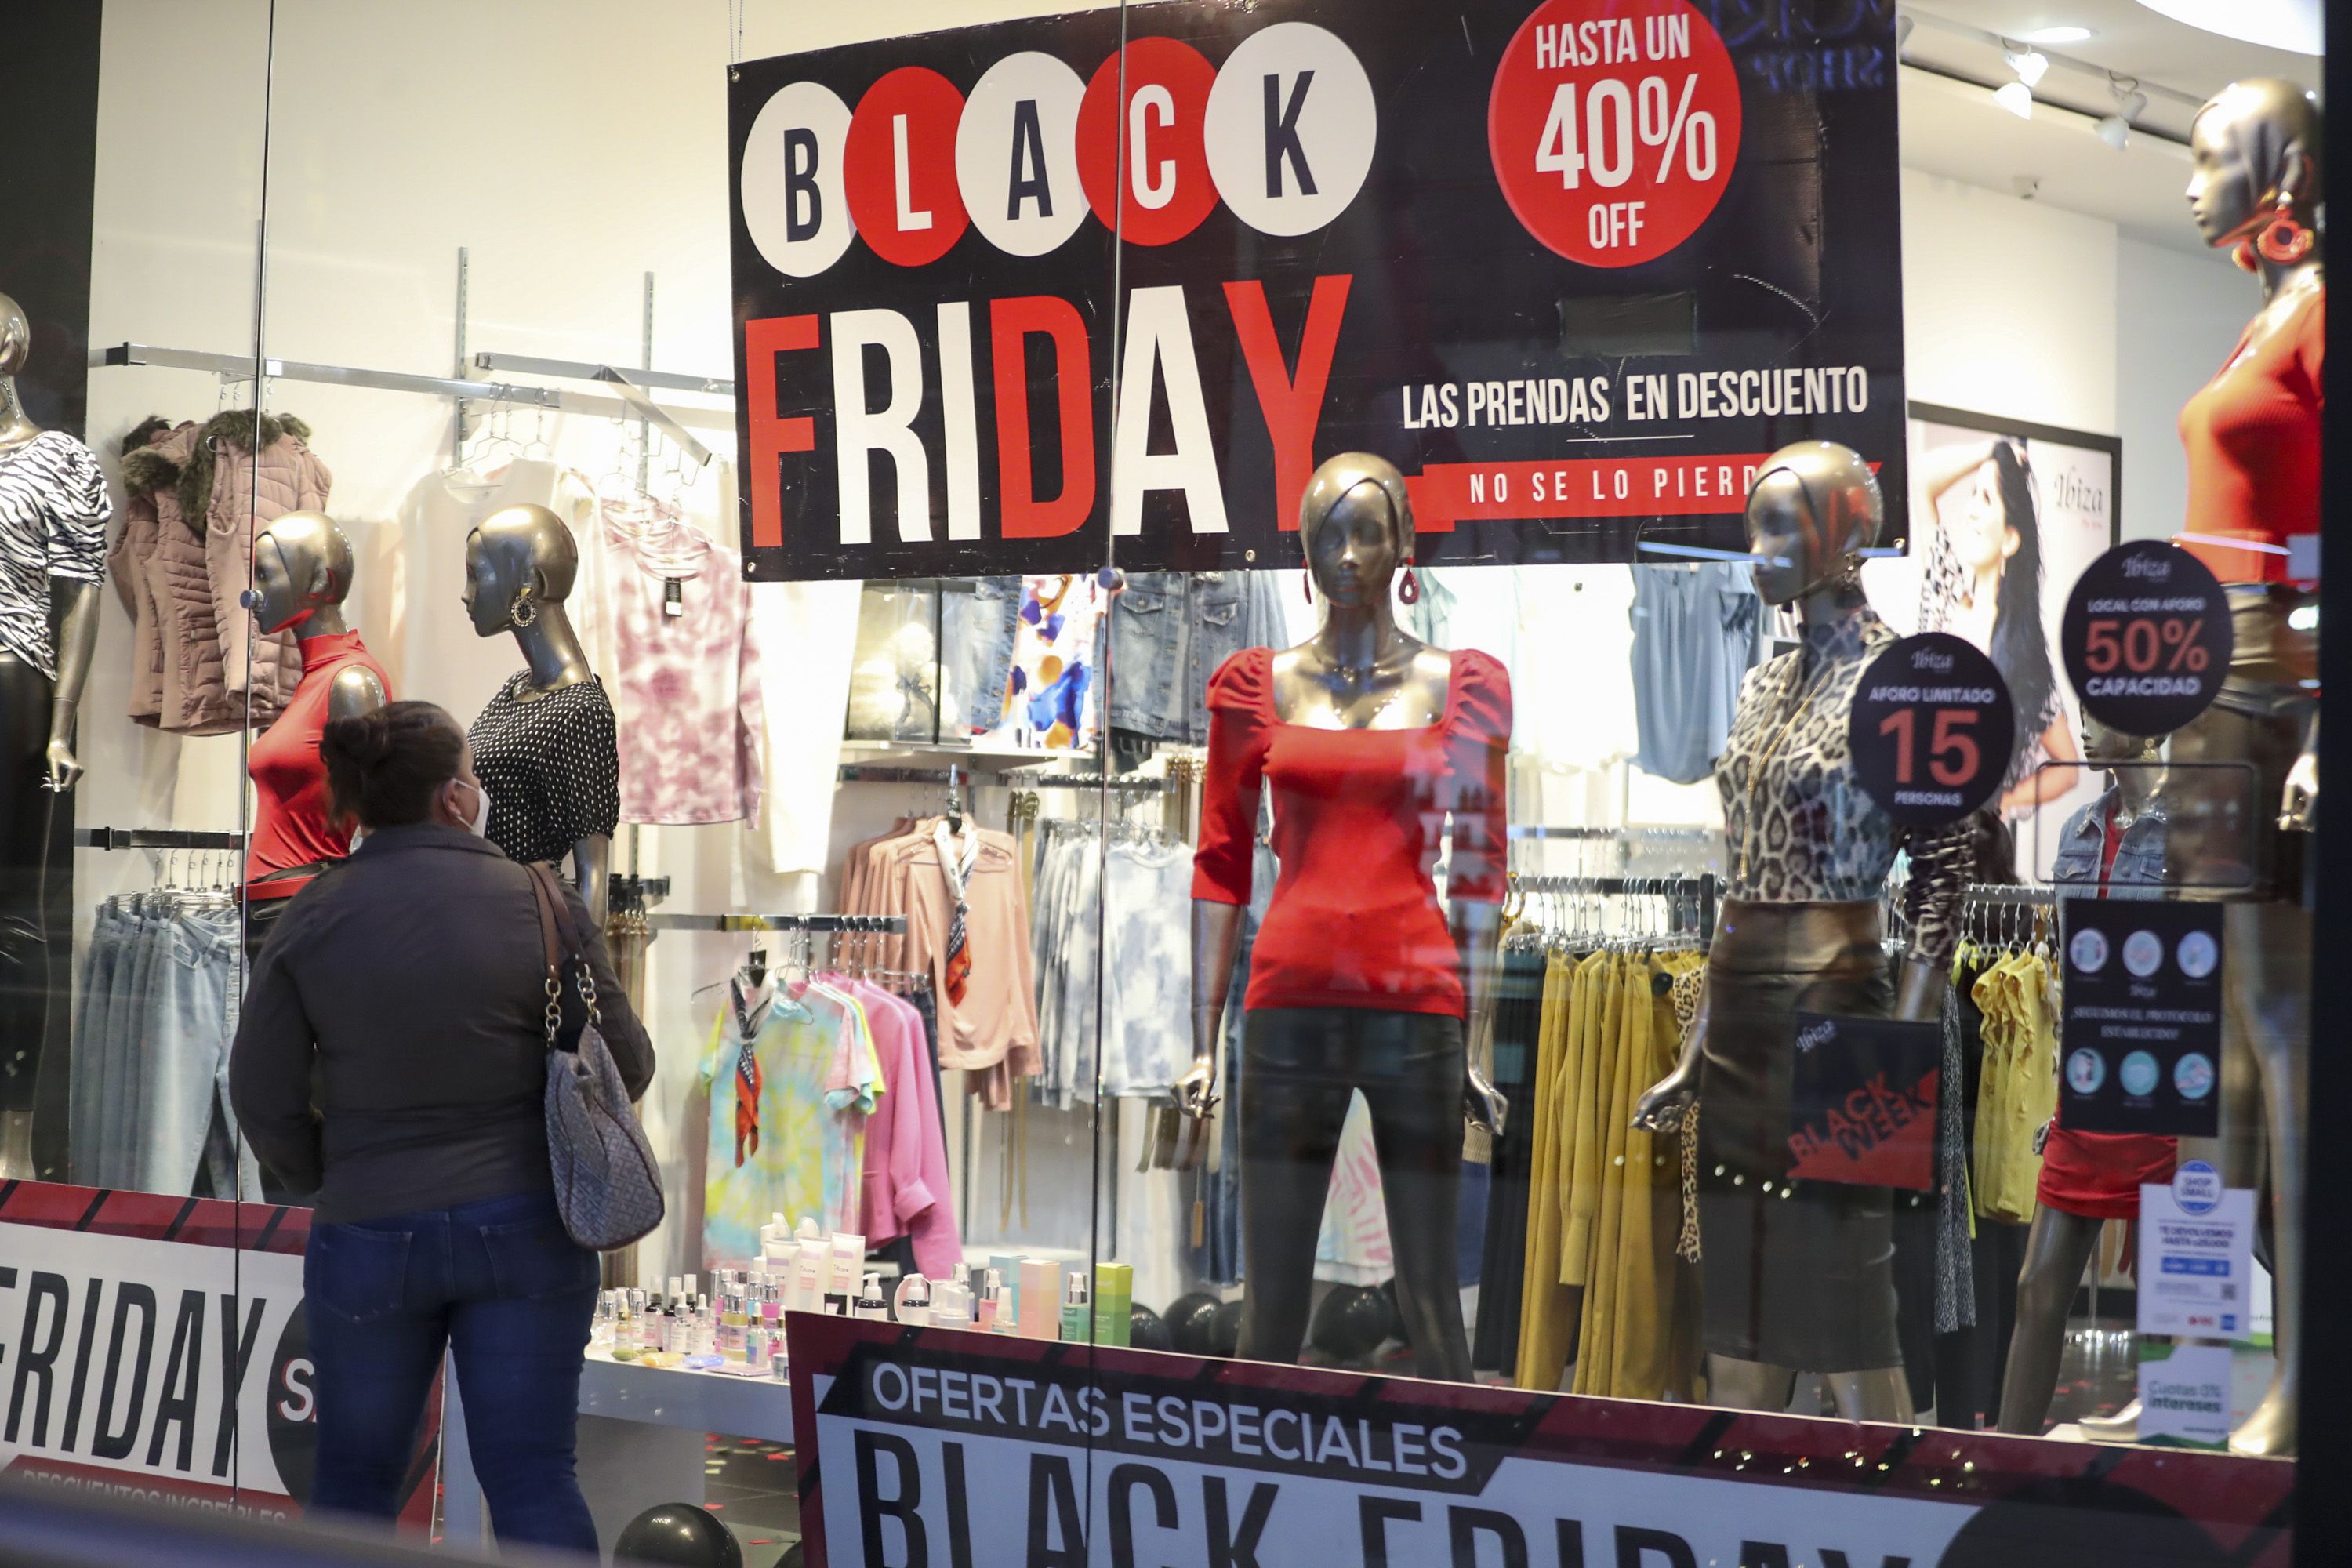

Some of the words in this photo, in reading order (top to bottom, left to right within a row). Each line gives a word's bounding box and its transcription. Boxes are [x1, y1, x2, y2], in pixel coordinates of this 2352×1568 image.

[1536, 18, 1638, 69] HASTA
[1646, 13, 1690, 60] UN
[783, 69, 1319, 243] BLACK
[1535, 73, 1717, 190] 40%
[1588, 201, 1646, 249] OFF
[745, 274, 1353, 547] FRIDAY
[1403, 383, 1459, 430] LAS
[1468, 377, 1610, 426] PRENDAS
[1627, 374, 1668, 421] EN
[1678, 365, 1868, 419] DESCUENTO
[1469, 473, 1508, 503] NO
[1532, 470, 1568, 503] SE
[1592, 469, 1630, 500] LO
[1653, 464, 1757, 498] PIERD
[2087, 598, 2129, 612] LOCAL
[2130, 597, 2158, 612] CON
[2161, 597, 2207, 612] AFORO
[2085, 617, 2209, 673] 50%
[1868, 685, 1921, 702] AFORO
[1922, 686, 1997, 704] LIMITADO
[2085, 676, 2202, 696] CAPACIDAD
[1879, 707, 1980, 787] 15
[1894, 790, 1963, 808] PERSONAS
[1787, 1071, 1896, 1163] BLACK
[1838, 1087, 1933, 1161] WEEK
[276, 1358, 317, 1423] S
[872, 1363, 1110, 1437] OFERTAS
[1124, 1393, 1468, 1479] ESPECIALES
[852, 1428, 1280, 1568] BLACK
